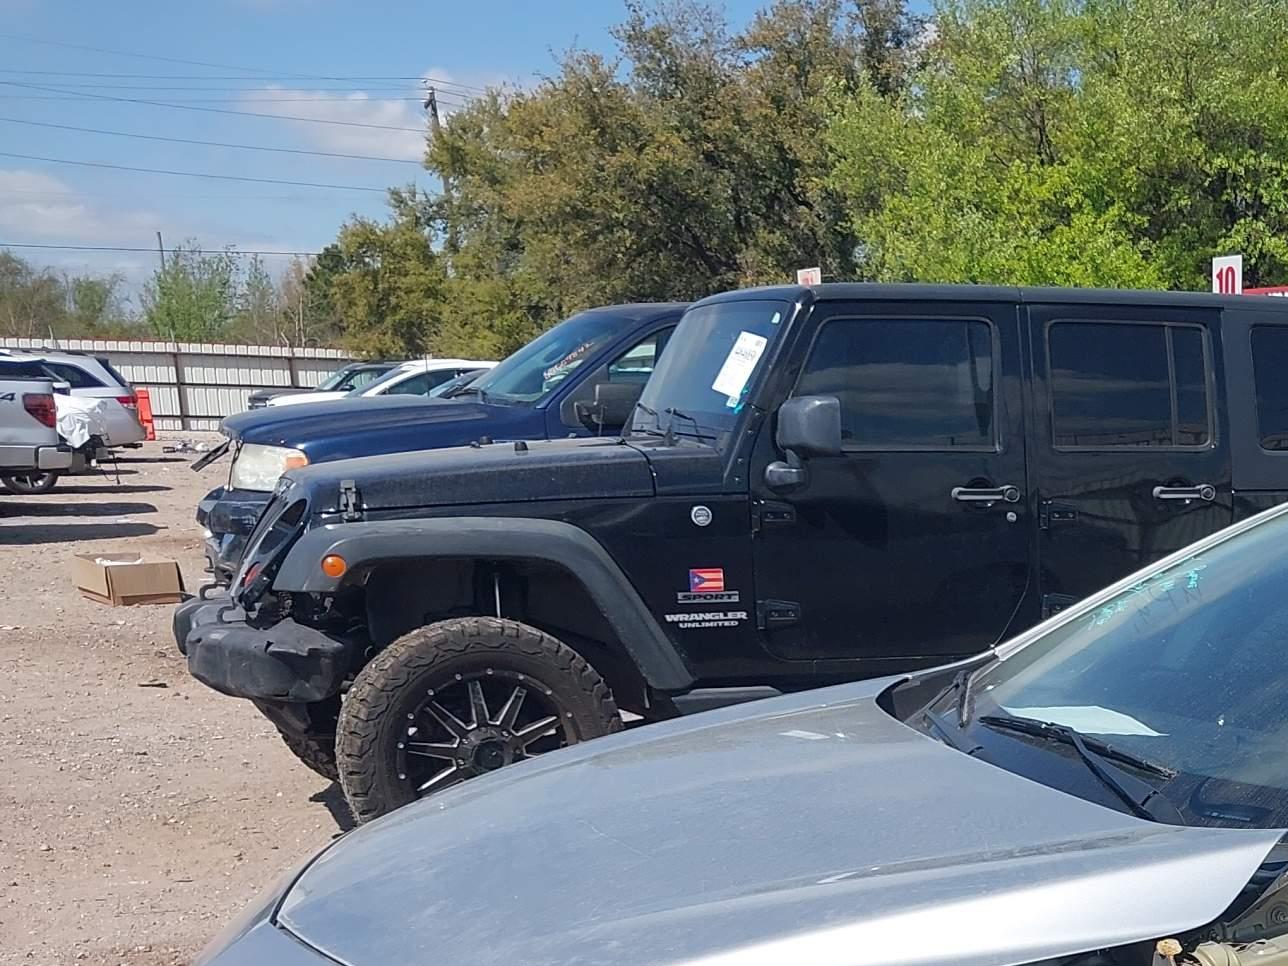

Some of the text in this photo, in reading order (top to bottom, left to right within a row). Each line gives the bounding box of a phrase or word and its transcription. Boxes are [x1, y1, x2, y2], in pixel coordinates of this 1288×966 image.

[1216, 265, 1236, 295] 10
[681, 593, 738, 601] SPORT
[665, 611, 748, 622] WRANGLER
[678, 619, 739, 629] UNLIMITED
